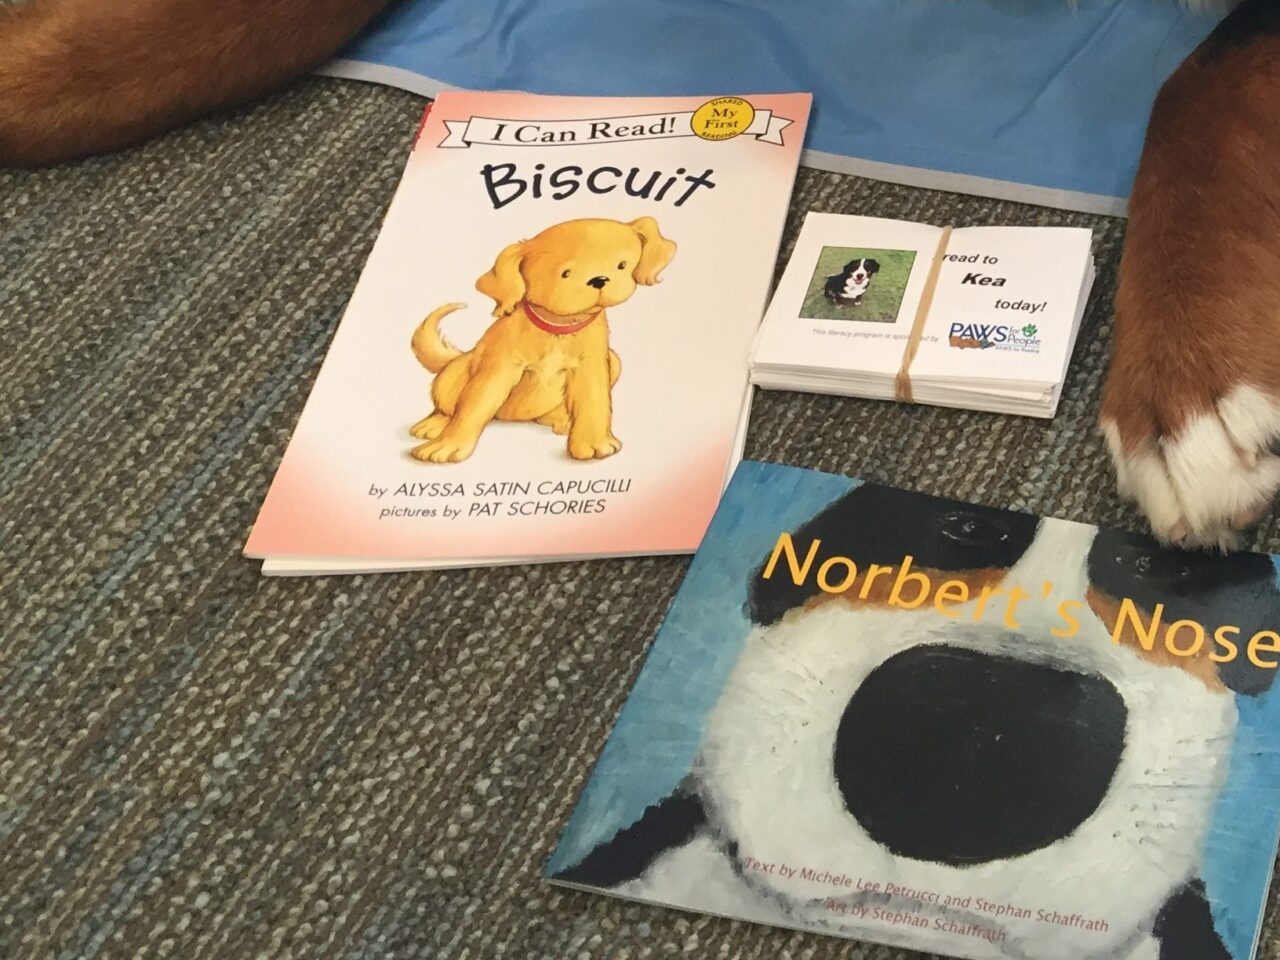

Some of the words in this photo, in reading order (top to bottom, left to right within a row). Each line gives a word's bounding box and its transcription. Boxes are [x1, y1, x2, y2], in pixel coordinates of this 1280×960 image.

[705, 119, 738, 129] First
[711, 108, 737, 120] My
[490, 123, 508, 141] I
[514, 125, 577, 143] Can
[588, 117, 677, 140] Read!
[480, 163, 716, 209] Biscuit
[942, 253, 981, 264] read
[982, 254, 999, 265] to
[960, 272, 1007, 287] Kea
[994, 299, 1048, 314] today!
[853, 331, 883, 340] program
[949, 322, 1009, 343] PAWS
[1009, 325, 1021, 334] for
[1008, 333, 1041, 347] People
[368, 483, 388, 499] by
[394, 482, 465, 497] ALYSSA
[472, 481, 531, 497] SATIN
[536, 478, 632, 496] CAPUCILLI
[379, 505, 437, 519] pictures
[443, 505, 462, 520] by
[468, 502, 501, 517] PAT
[507, 499, 607, 516] SCHORIES
[762, 531, 1084, 640] Norbert's
[744, 856, 776, 873] Text
[779, 863, 797, 879] by
[800, 868, 852, 888] Michele
[856, 877, 881, 892] Lee
[884, 882, 940, 903] Petrucci
[944, 895, 972, 909] and
[974, 898, 1032, 919] Stephan
[1035, 908, 1110, 932] Schaffrath
[826, 899, 848, 913] Art
[851, 903, 869, 918] by
[872, 907, 929, 928] Stephan
[933, 917, 1007, 942] Schaffrath
